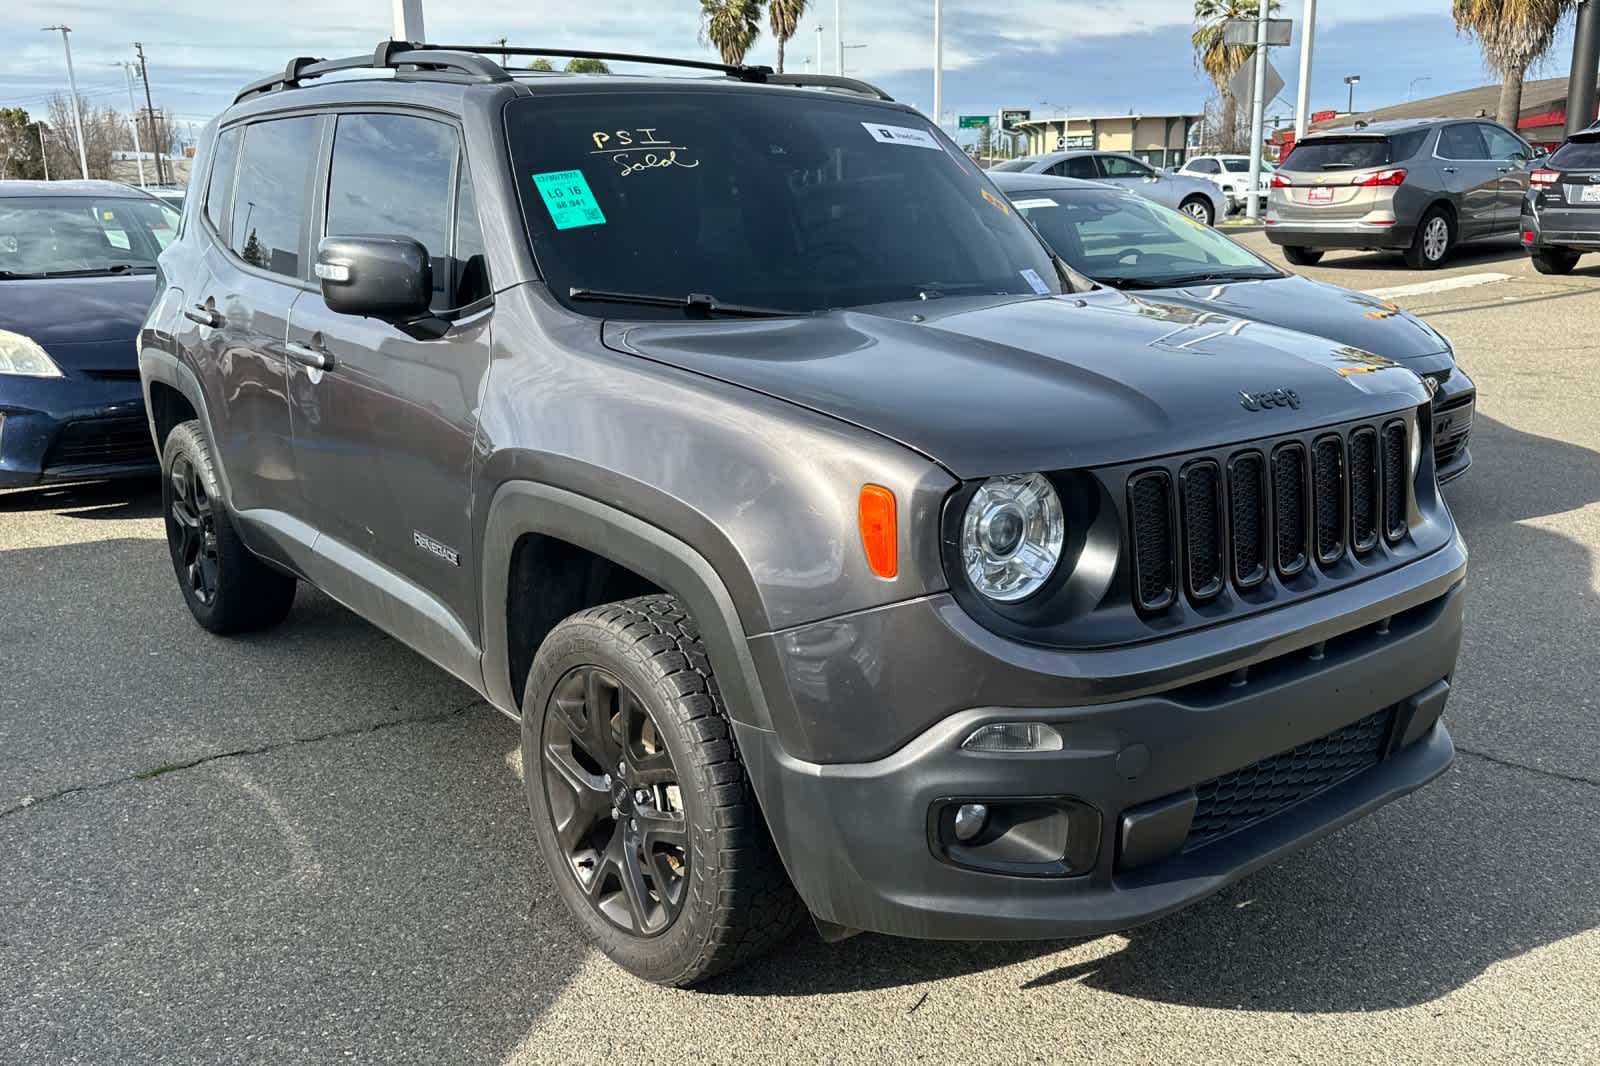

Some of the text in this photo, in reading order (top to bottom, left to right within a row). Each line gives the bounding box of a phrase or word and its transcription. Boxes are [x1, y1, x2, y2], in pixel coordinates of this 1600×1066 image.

[591, 128, 672, 149] PSI
[546, 185, 582, 199] LG 16
[1239, 388, 1300, 413] Jeep
[413, 529, 460, 566] RENEGADE
